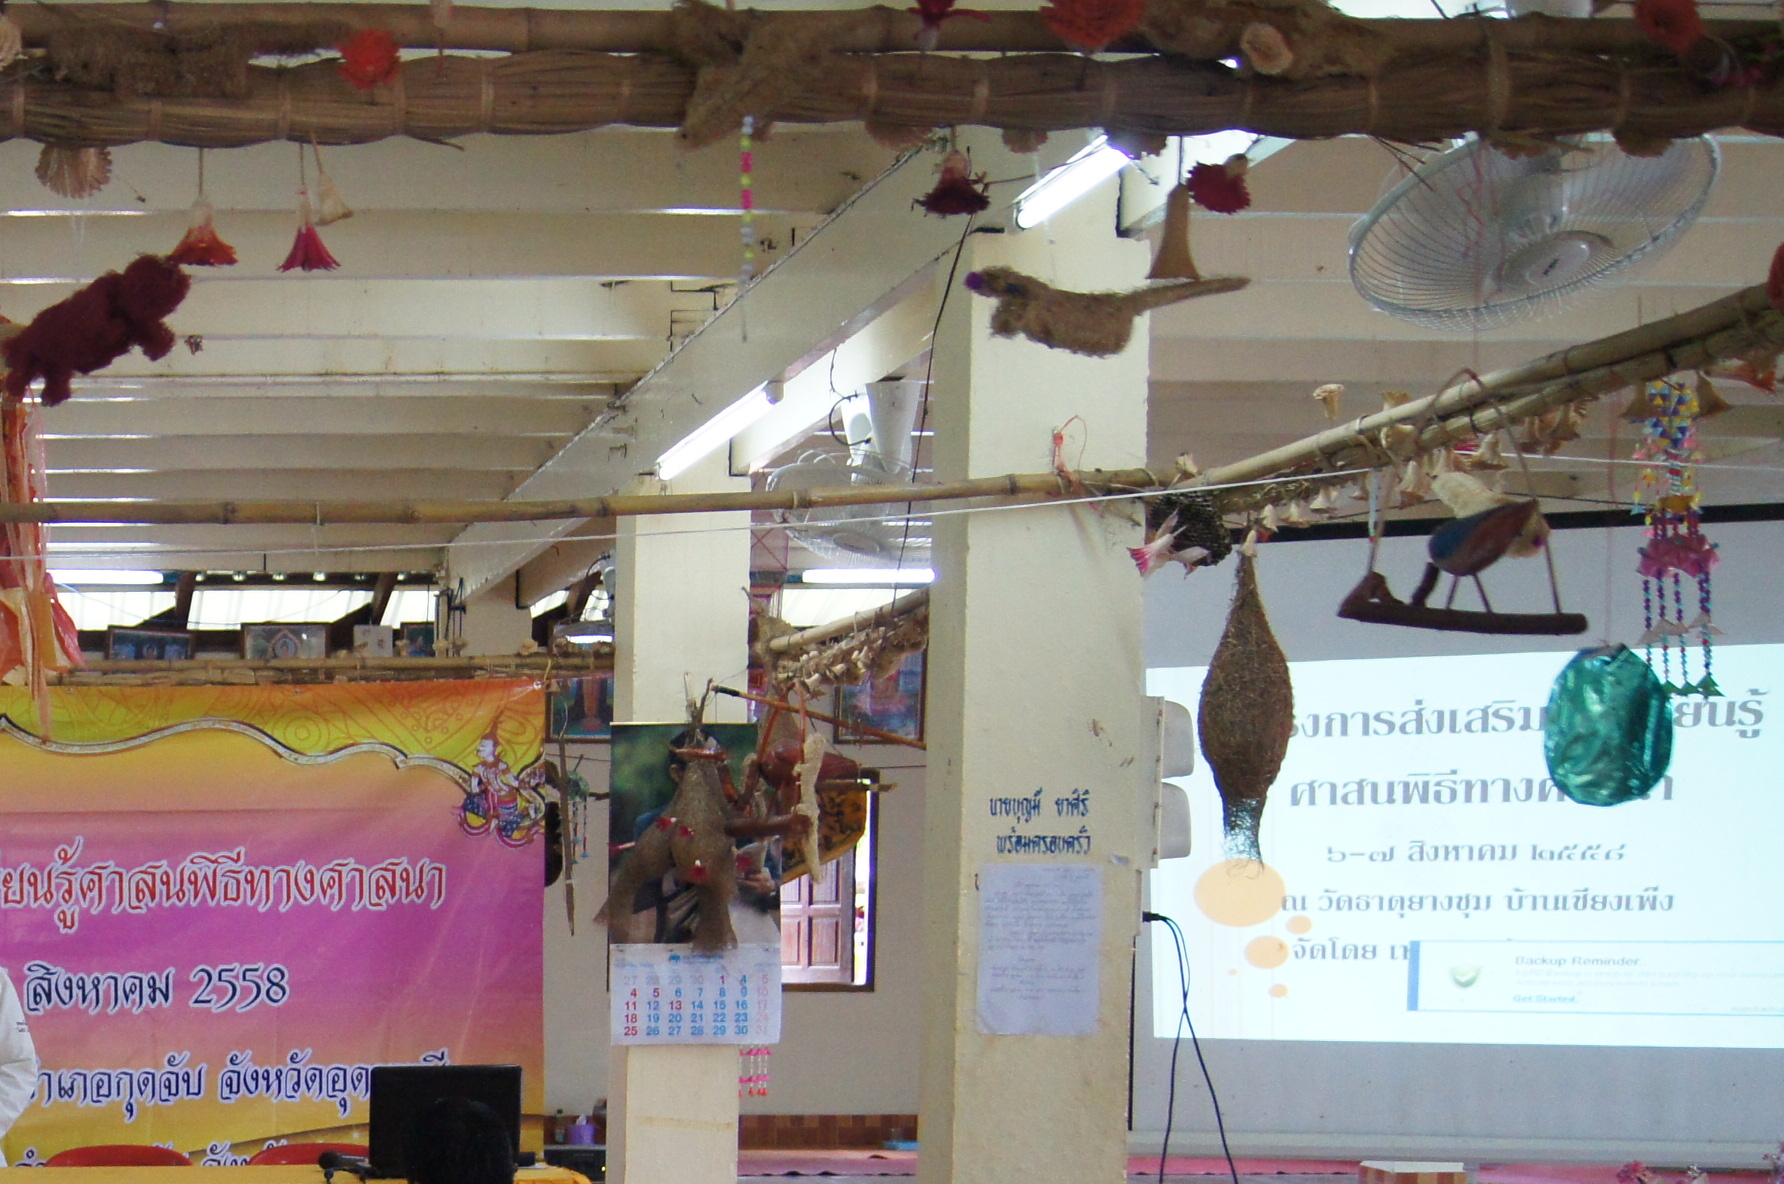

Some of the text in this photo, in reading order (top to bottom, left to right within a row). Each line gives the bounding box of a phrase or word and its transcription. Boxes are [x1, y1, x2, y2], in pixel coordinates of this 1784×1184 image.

[996, 825, 1092, 854] พร้อมครอบครัว
[1408, 840, 1517, 863] สิงหาคม
[1281, 893, 1307, 912] ณ
[1317, 889, 1491, 919] วัดธาตุยางชุม
[1292, 937, 1378, 961] จัดโดย
[1515, 956, 1640, 968] Backup Reminder
[720, 975, 725, 985] 1
[26, 962, 173, 1015] สิงหาคม
[191, 963, 290, 1015] 2558
[630, 988, 637, 998] 4
[653, 988, 660, 998] 5
[675, 988, 682, 998] 6
[697, 988, 704, 998] 7
[719, 988, 726, 998] 8
[1513, 994, 1534, 1004] Get
[624, 1001, 637, 1011] 11
[646, 1001, 660, 1011] 12
[668, 1001, 682, 1011] 13
[690, 1001, 704, 1011] 14
[713, 1001, 726, 1011] 15
[735, 1001, 748, 1011] 16
[624, 1013, 637, 1023] 18
[646, 1013, 660, 1023] 19
[668, 1013, 682, 1023] 20
[690, 1013, 704, 1023] 21
[713, 1013, 726, 1023] 22
[735, 1013, 748, 1023] 23
[624, 1025, 637, 1036] 25
[646, 1025, 660, 1036] 26
[668, 1025, 682, 1036] 27
[690, 1025, 704, 1036] 28
[713, 1025, 726, 1036] 29
[735, 1025, 748, 1036] 30
